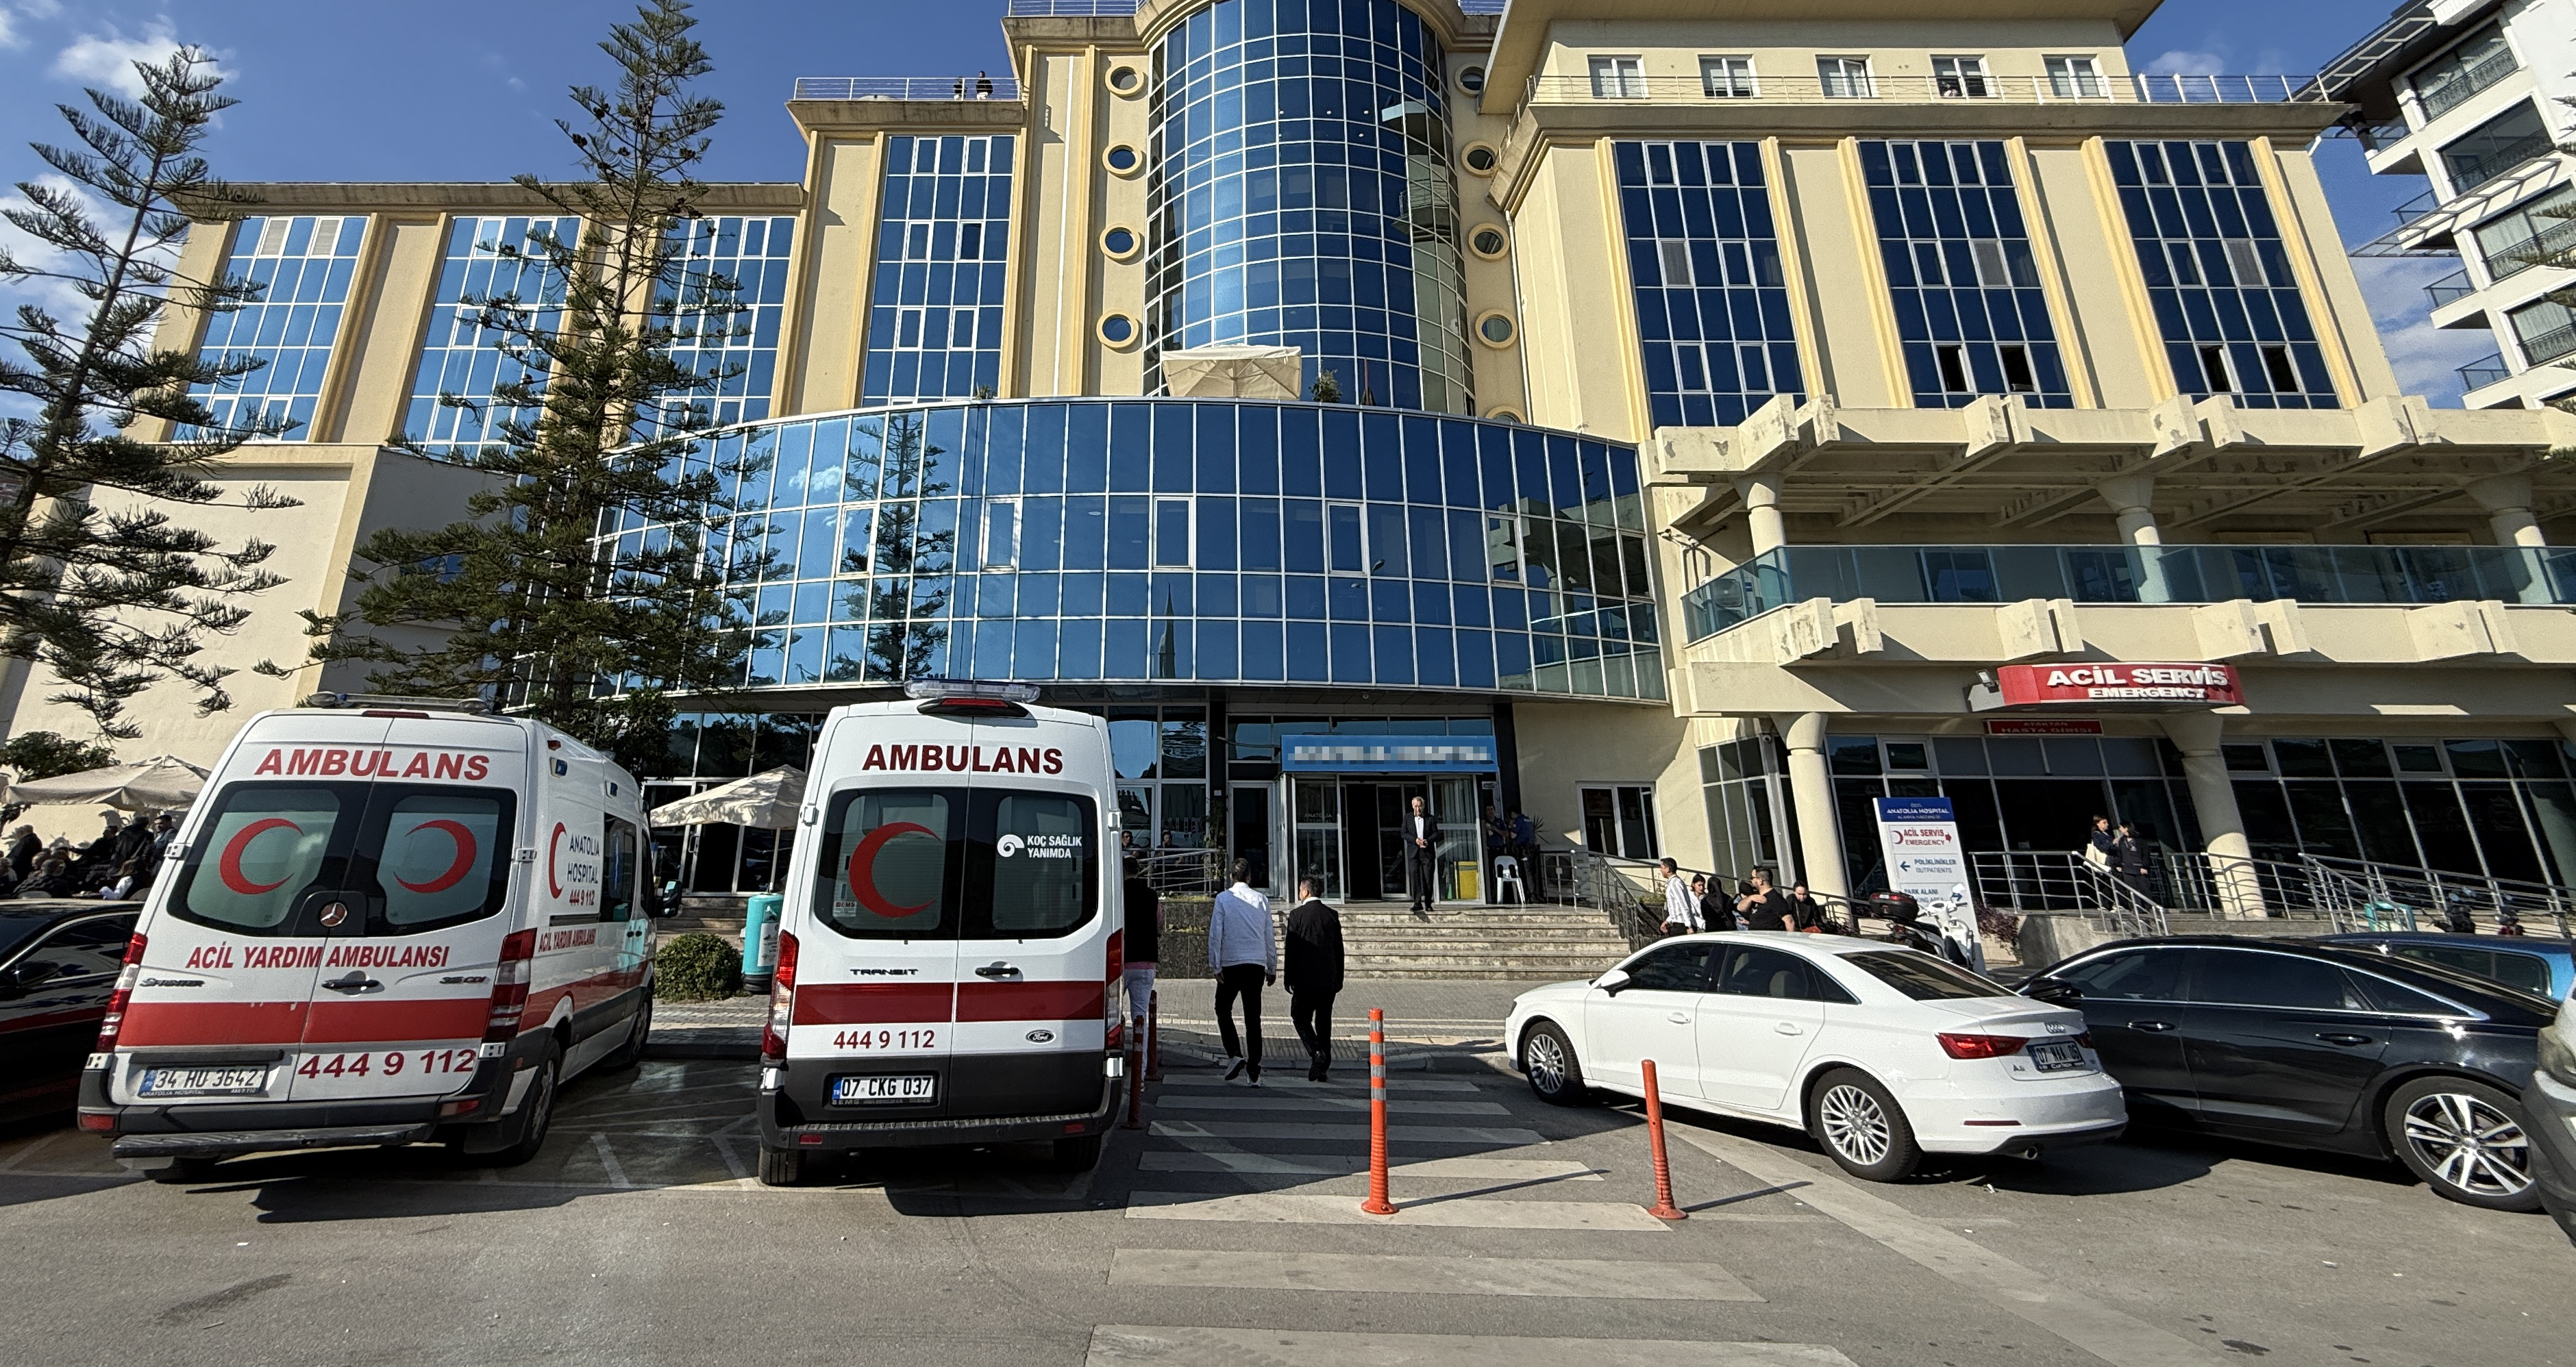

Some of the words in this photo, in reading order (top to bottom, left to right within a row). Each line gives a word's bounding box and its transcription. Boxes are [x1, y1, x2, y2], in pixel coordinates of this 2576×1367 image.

[2046, 666, 2127, 686] ACİL
[2131, 666, 2228, 686] SERVİS
[2088, 687, 2207, 699] EMERGENCY
[253, 749, 490, 781] AMBULANS
[862, 744, 1063, 775] AMBULANS
[1028, 835, 1046, 847] KOÇ
[1049, 834, 1082, 846] SAĞLIK
[1904, 827, 1919, 836] ACİL
[1920, 827, 1944, 837] SERVİS
[569, 834, 600, 857] ANATOLIA
[1028, 848, 1072, 859] YANIMDA
[567, 863, 598, 884] HOSPITAL
[569, 888, 580, 906] 444
[580, 889, 584, 906] 9
[585, 889, 595, 906] 112
[553, 930, 572, 951] YARDIM
[186, 940, 234, 968] ACİL
[243, 946, 323, 968] YARDIM
[325, 946, 450, 968] AMBULANSI
[833, 1030, 872, 1049] 444
[878, 1030, 891, 1049] 9
[898, 1029, 934, 1049] 112
[297, 1053, 371, 1079] 444
[383, 1051, 404, 1076] 9
[420, 1049, 477, 1073] 112
[156, 1070, 177, 1088] 34
[184, 1069, 208, 1088] HU
[212, 1068, 258, 1087] 3642
[842, 1079, 860, 1097] 07
[869, 1078, 897, 1096] CKG
[903, 1077, 932, 1095] 037
